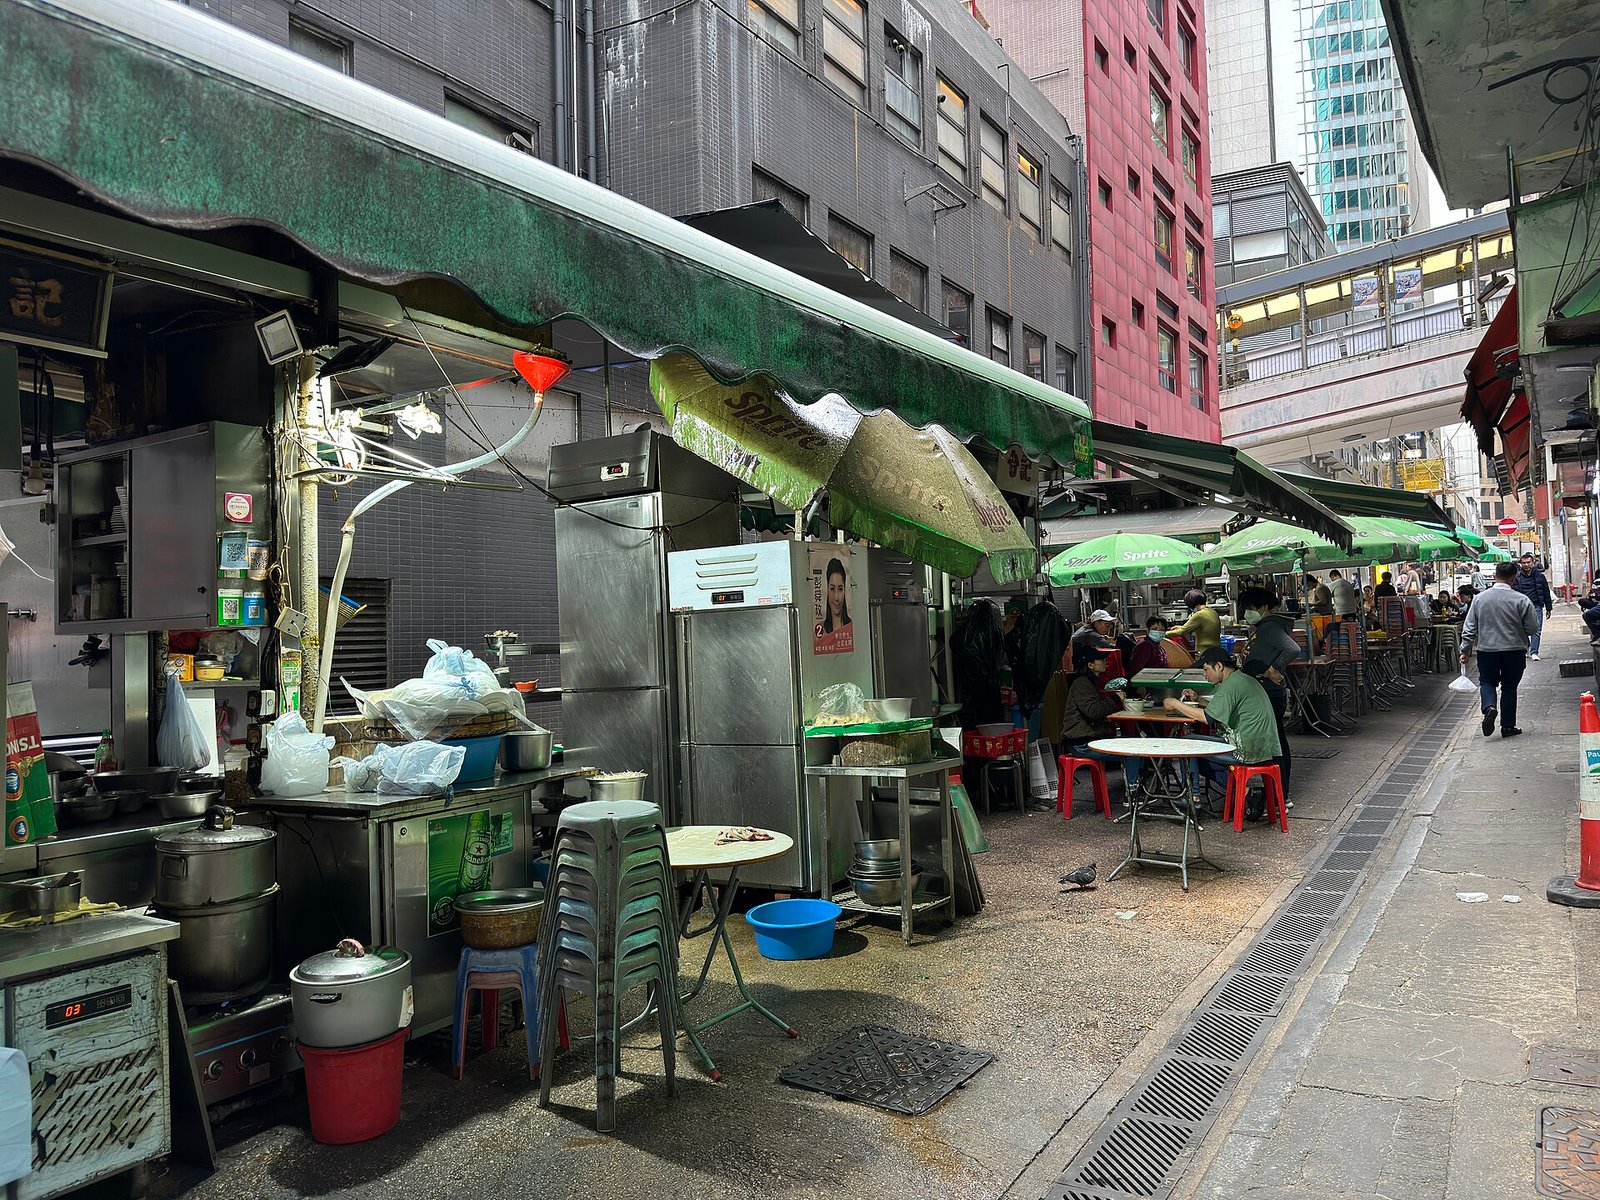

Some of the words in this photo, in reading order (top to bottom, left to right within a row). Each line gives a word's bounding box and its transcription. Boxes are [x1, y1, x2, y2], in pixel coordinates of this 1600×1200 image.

[9, 268, 65, 327] 記
[723, 391, 828, 451] Sprite
[1064, 554, 1108, 568] Sprite
[1123, 550, 1169, 562] Sprite
[816, 625, 823, 637] 2
[65, 1004, 81, 1018] 03
